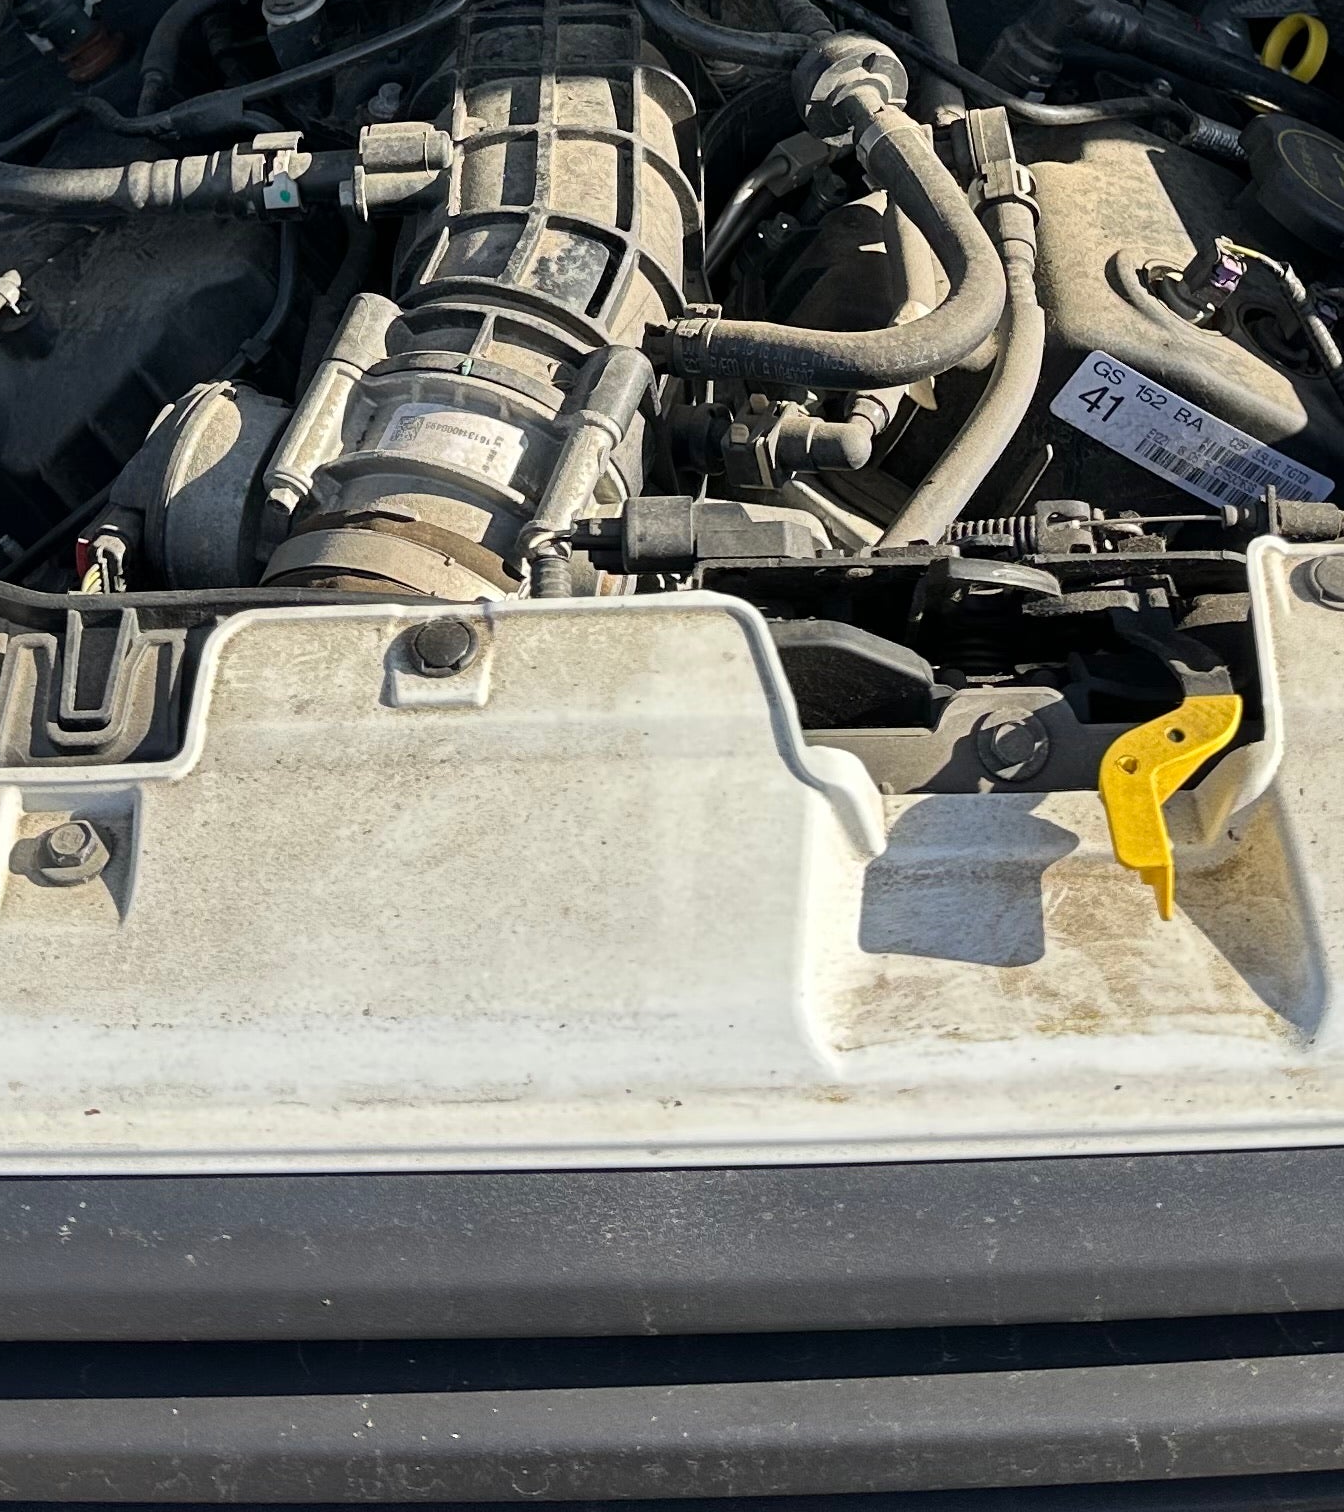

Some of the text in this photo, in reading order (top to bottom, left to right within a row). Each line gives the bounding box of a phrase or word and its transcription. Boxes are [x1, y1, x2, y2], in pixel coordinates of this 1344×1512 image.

[1078, 386, 1125, 422] 41
[1094, 360, 1126, 385] GS
[1135, 384, 1168, 411] 152
[1173, 406, 1204, 433] BA
